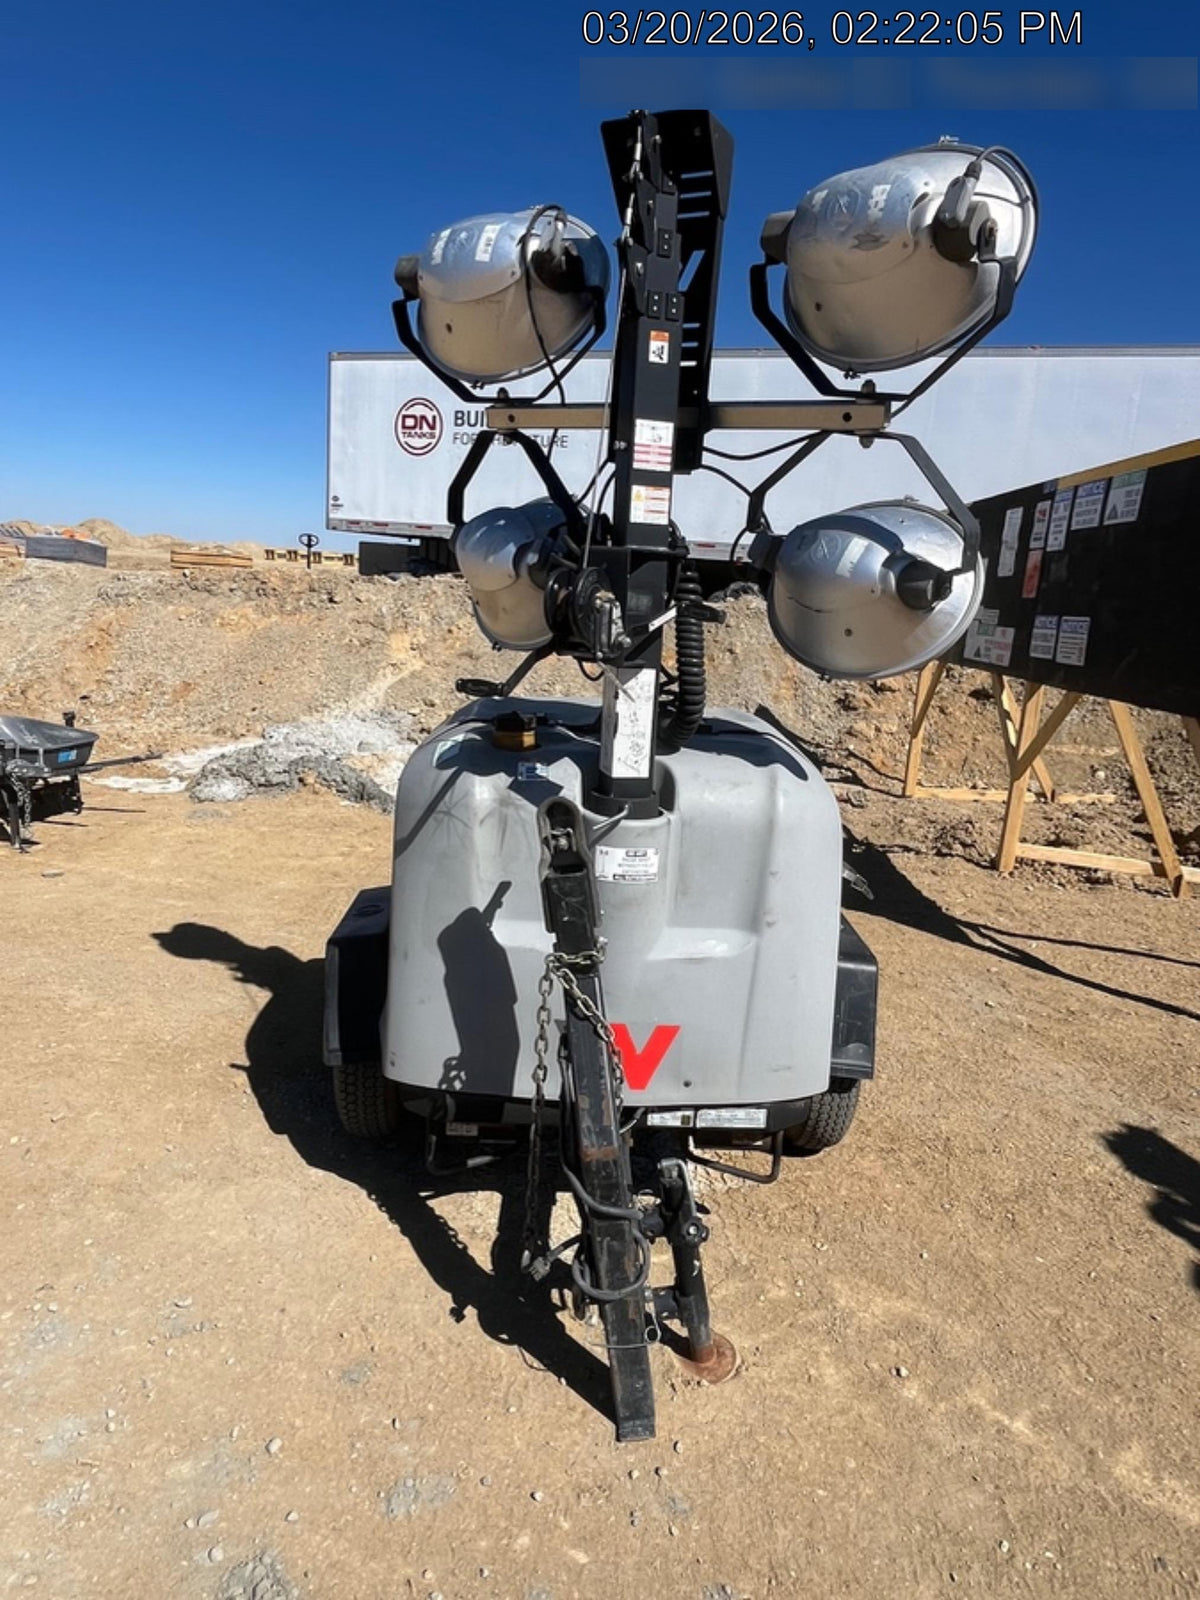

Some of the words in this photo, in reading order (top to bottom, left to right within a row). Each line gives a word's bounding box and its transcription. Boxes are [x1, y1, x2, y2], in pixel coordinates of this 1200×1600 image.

[401, 414, 436, 430] DN
[454, 410, 484, 427] BUI
[401, 431, 436, 440] TANKS
